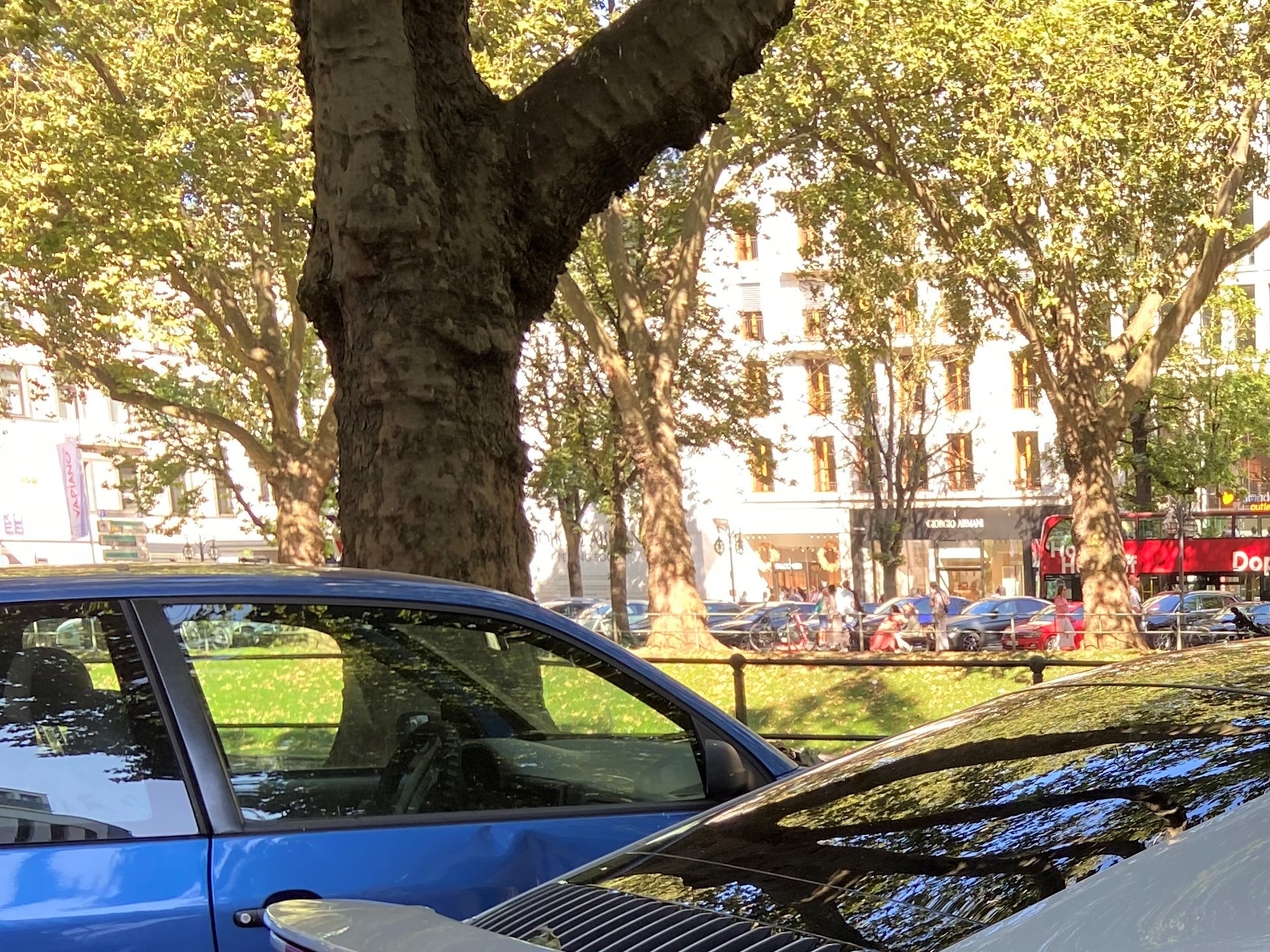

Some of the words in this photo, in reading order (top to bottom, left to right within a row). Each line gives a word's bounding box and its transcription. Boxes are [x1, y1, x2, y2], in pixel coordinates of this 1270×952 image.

[64, 450, 81, 519] VAPIANO
[925, 519, 957, 529] GIORGIO
[957, 518, 985, 528] ARMANI
